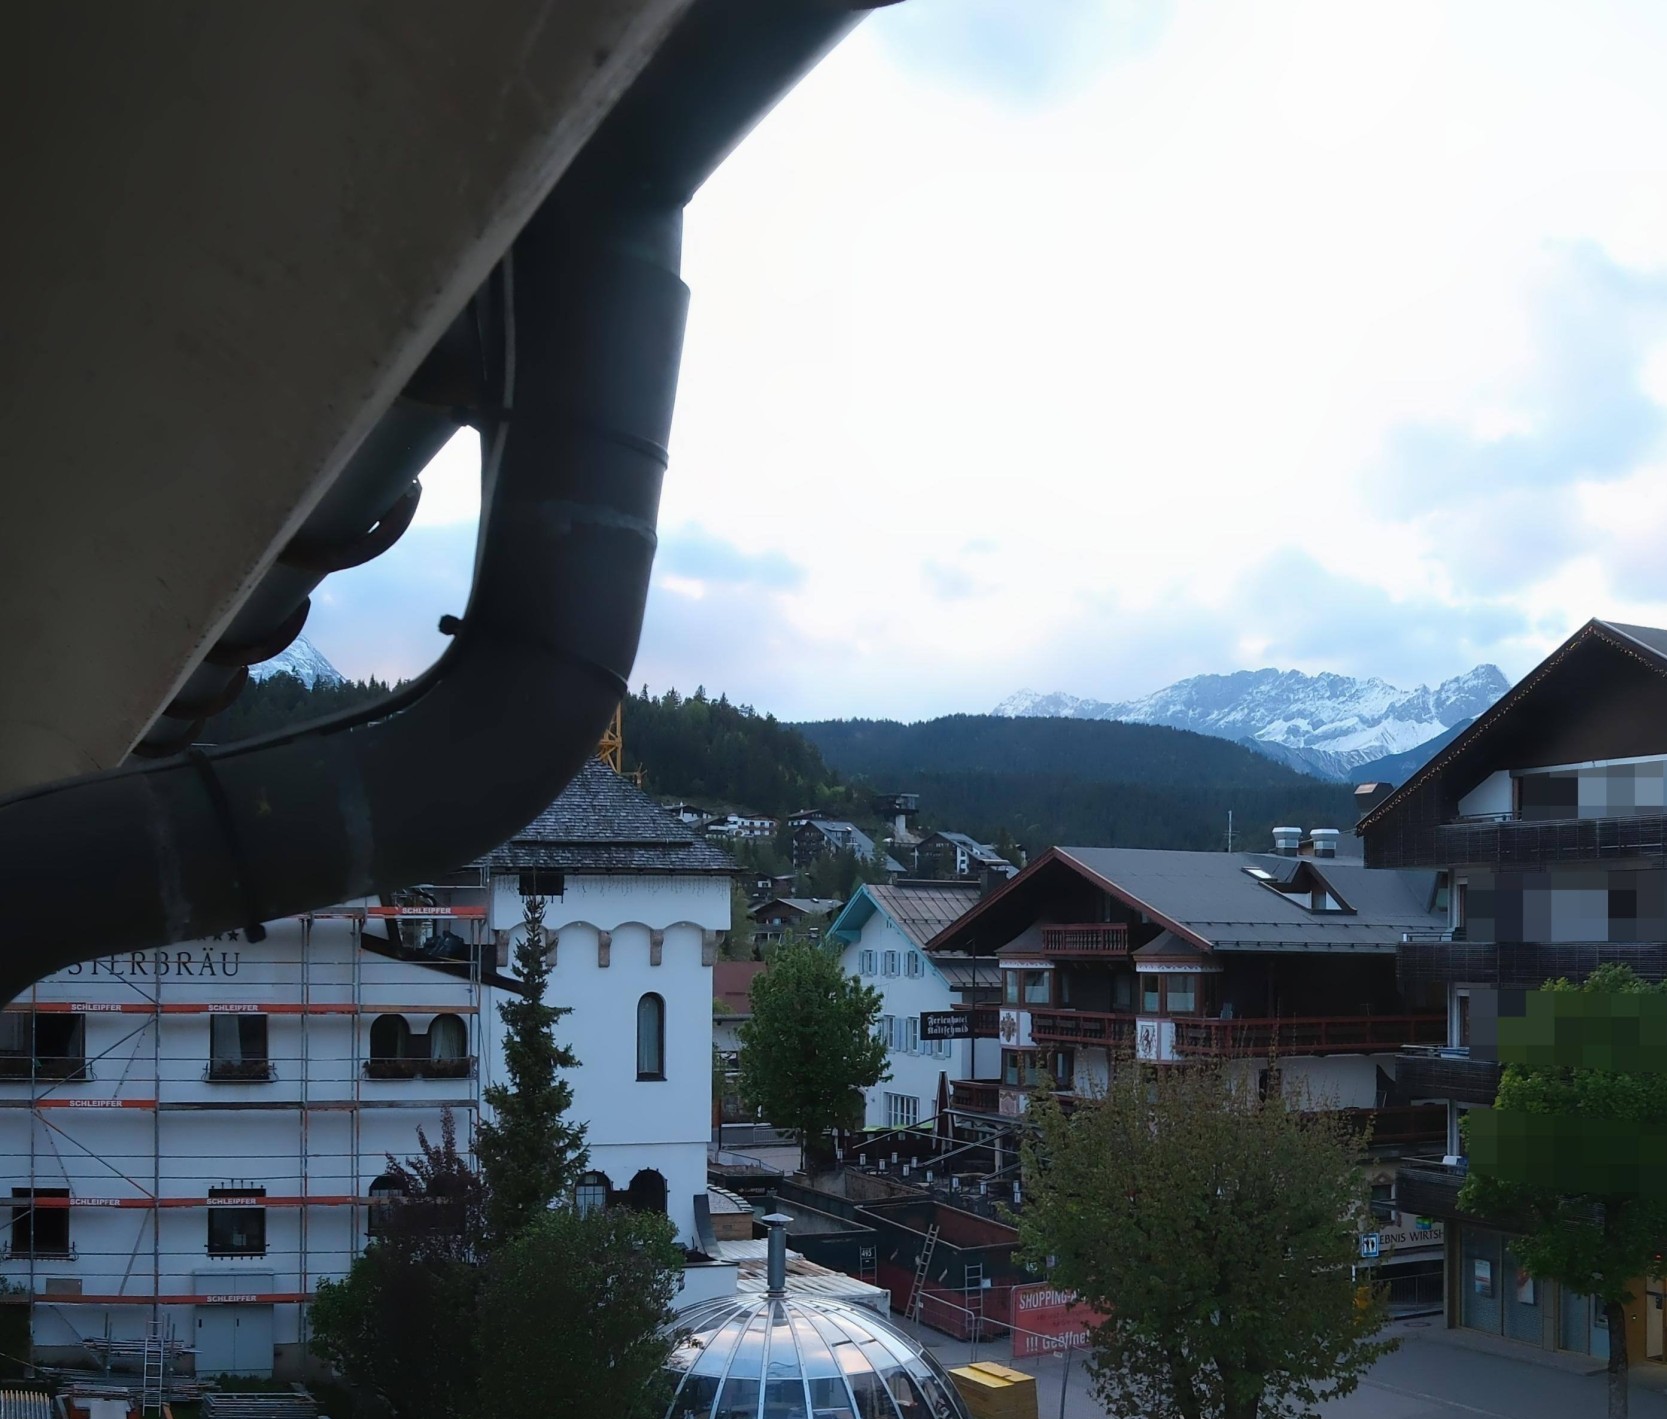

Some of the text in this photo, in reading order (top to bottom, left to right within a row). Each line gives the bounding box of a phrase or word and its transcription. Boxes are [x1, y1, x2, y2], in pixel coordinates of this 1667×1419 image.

[47, 947, 240, 977] STERBRÄU
[71, 1003, 122, 1012] SCHLEIPFER
[208, 1003, 259, 1012] SCHLEIPFER
